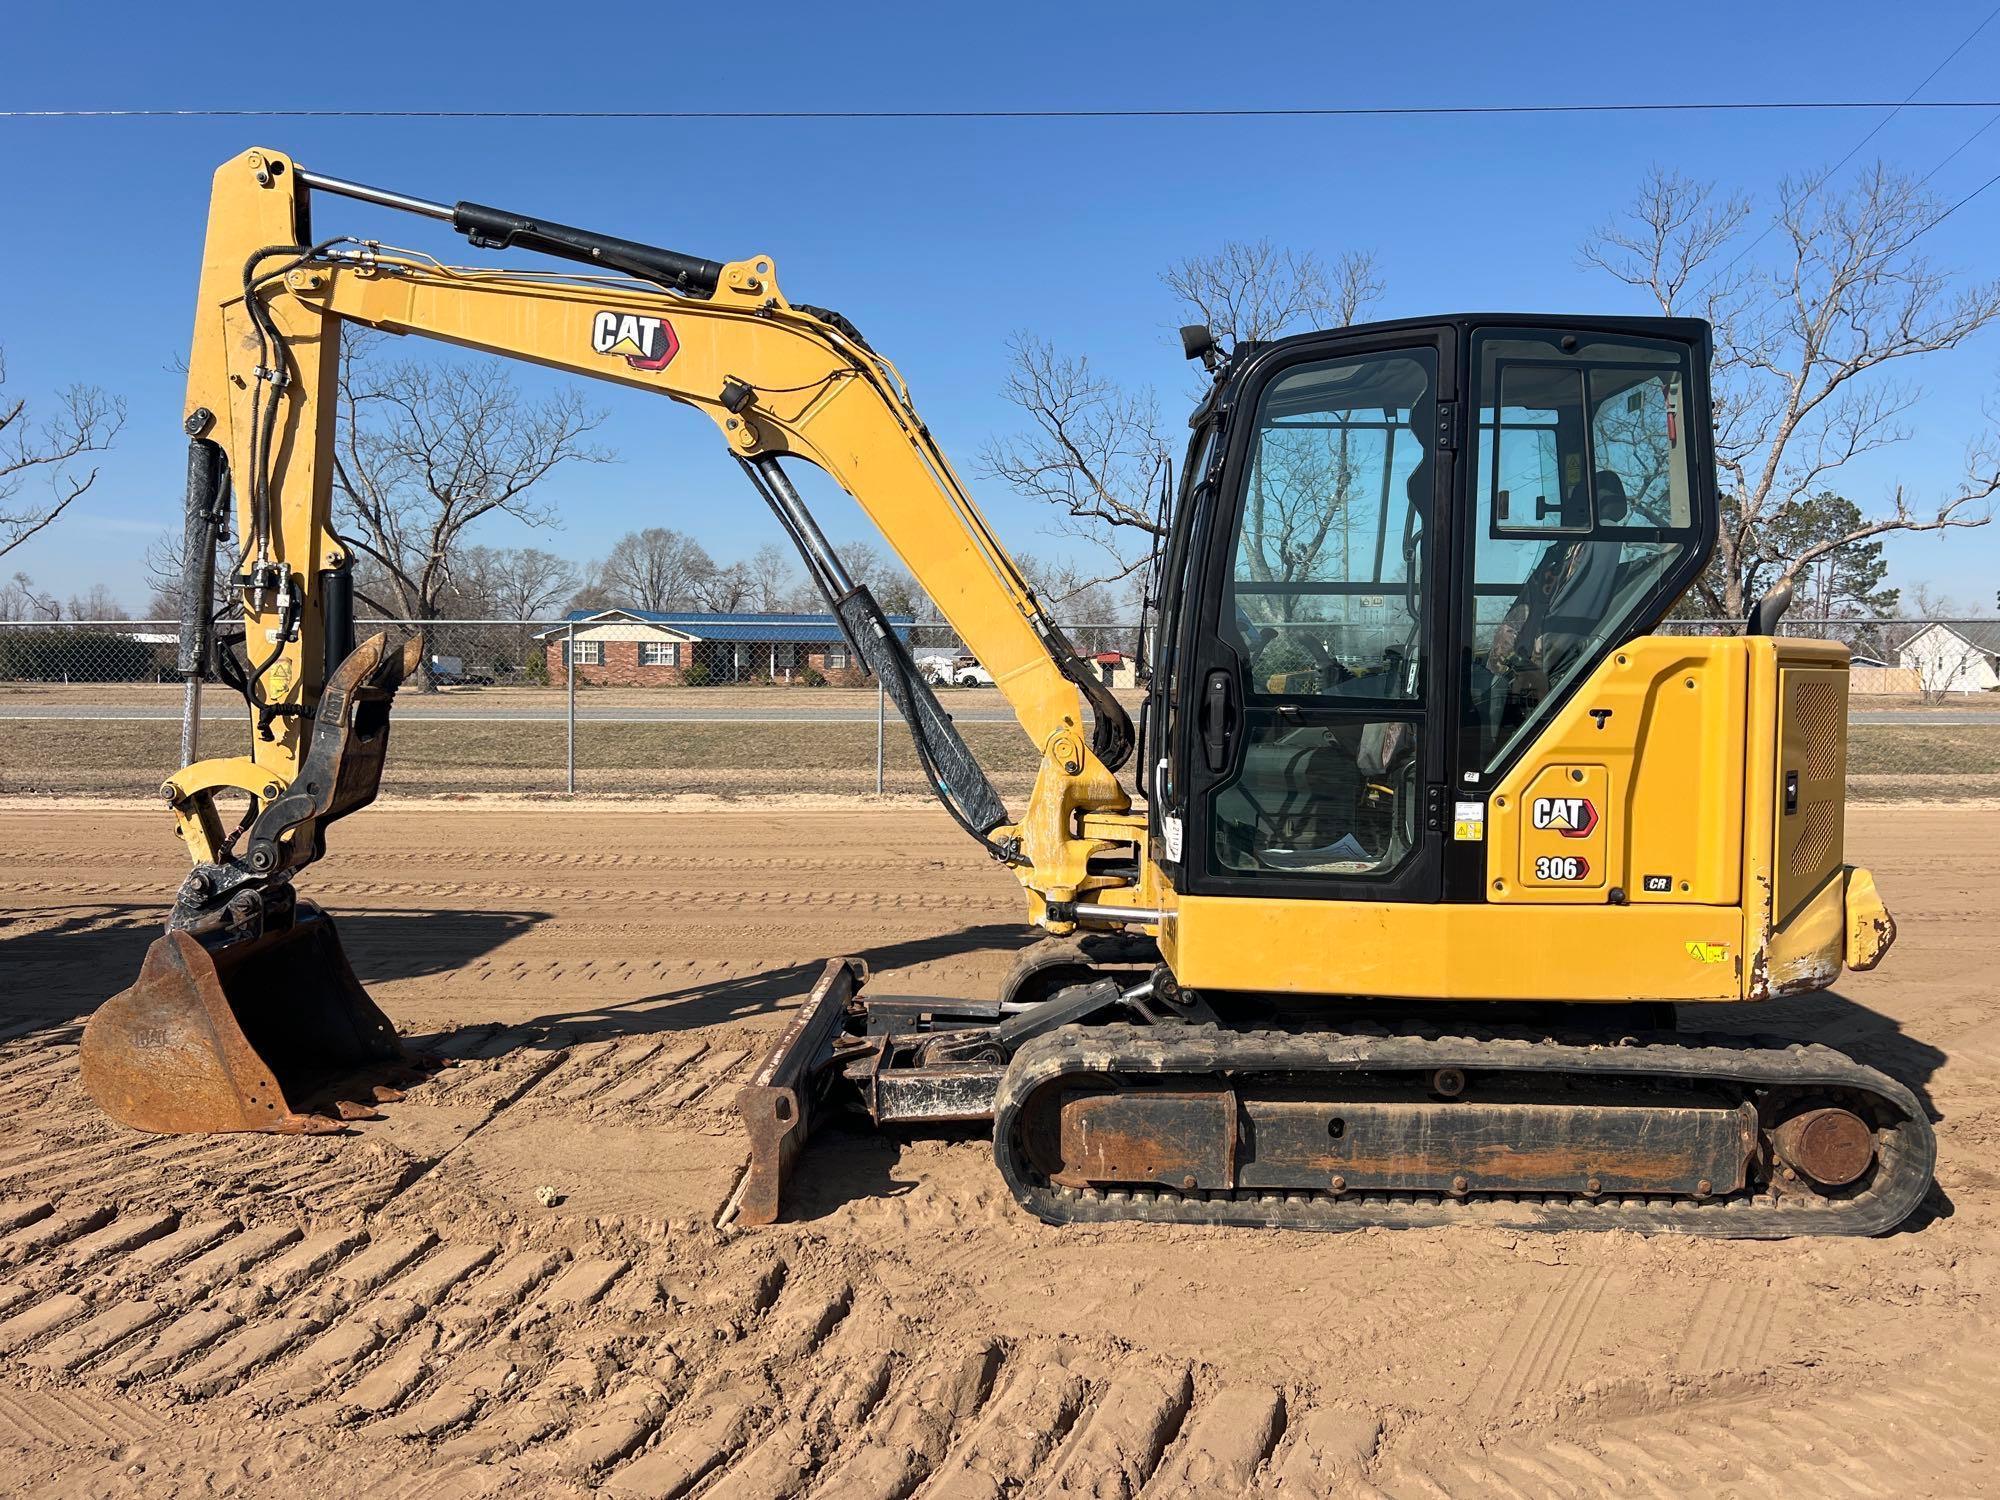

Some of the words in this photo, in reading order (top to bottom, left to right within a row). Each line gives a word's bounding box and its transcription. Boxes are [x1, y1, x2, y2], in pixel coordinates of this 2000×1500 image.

[593, 311, 661, 358] CAT
[1534, 798, 1583, 829] CAT
[1536, 857, 1577, 879] 306
[1649, 877, 1667, 889] CR
